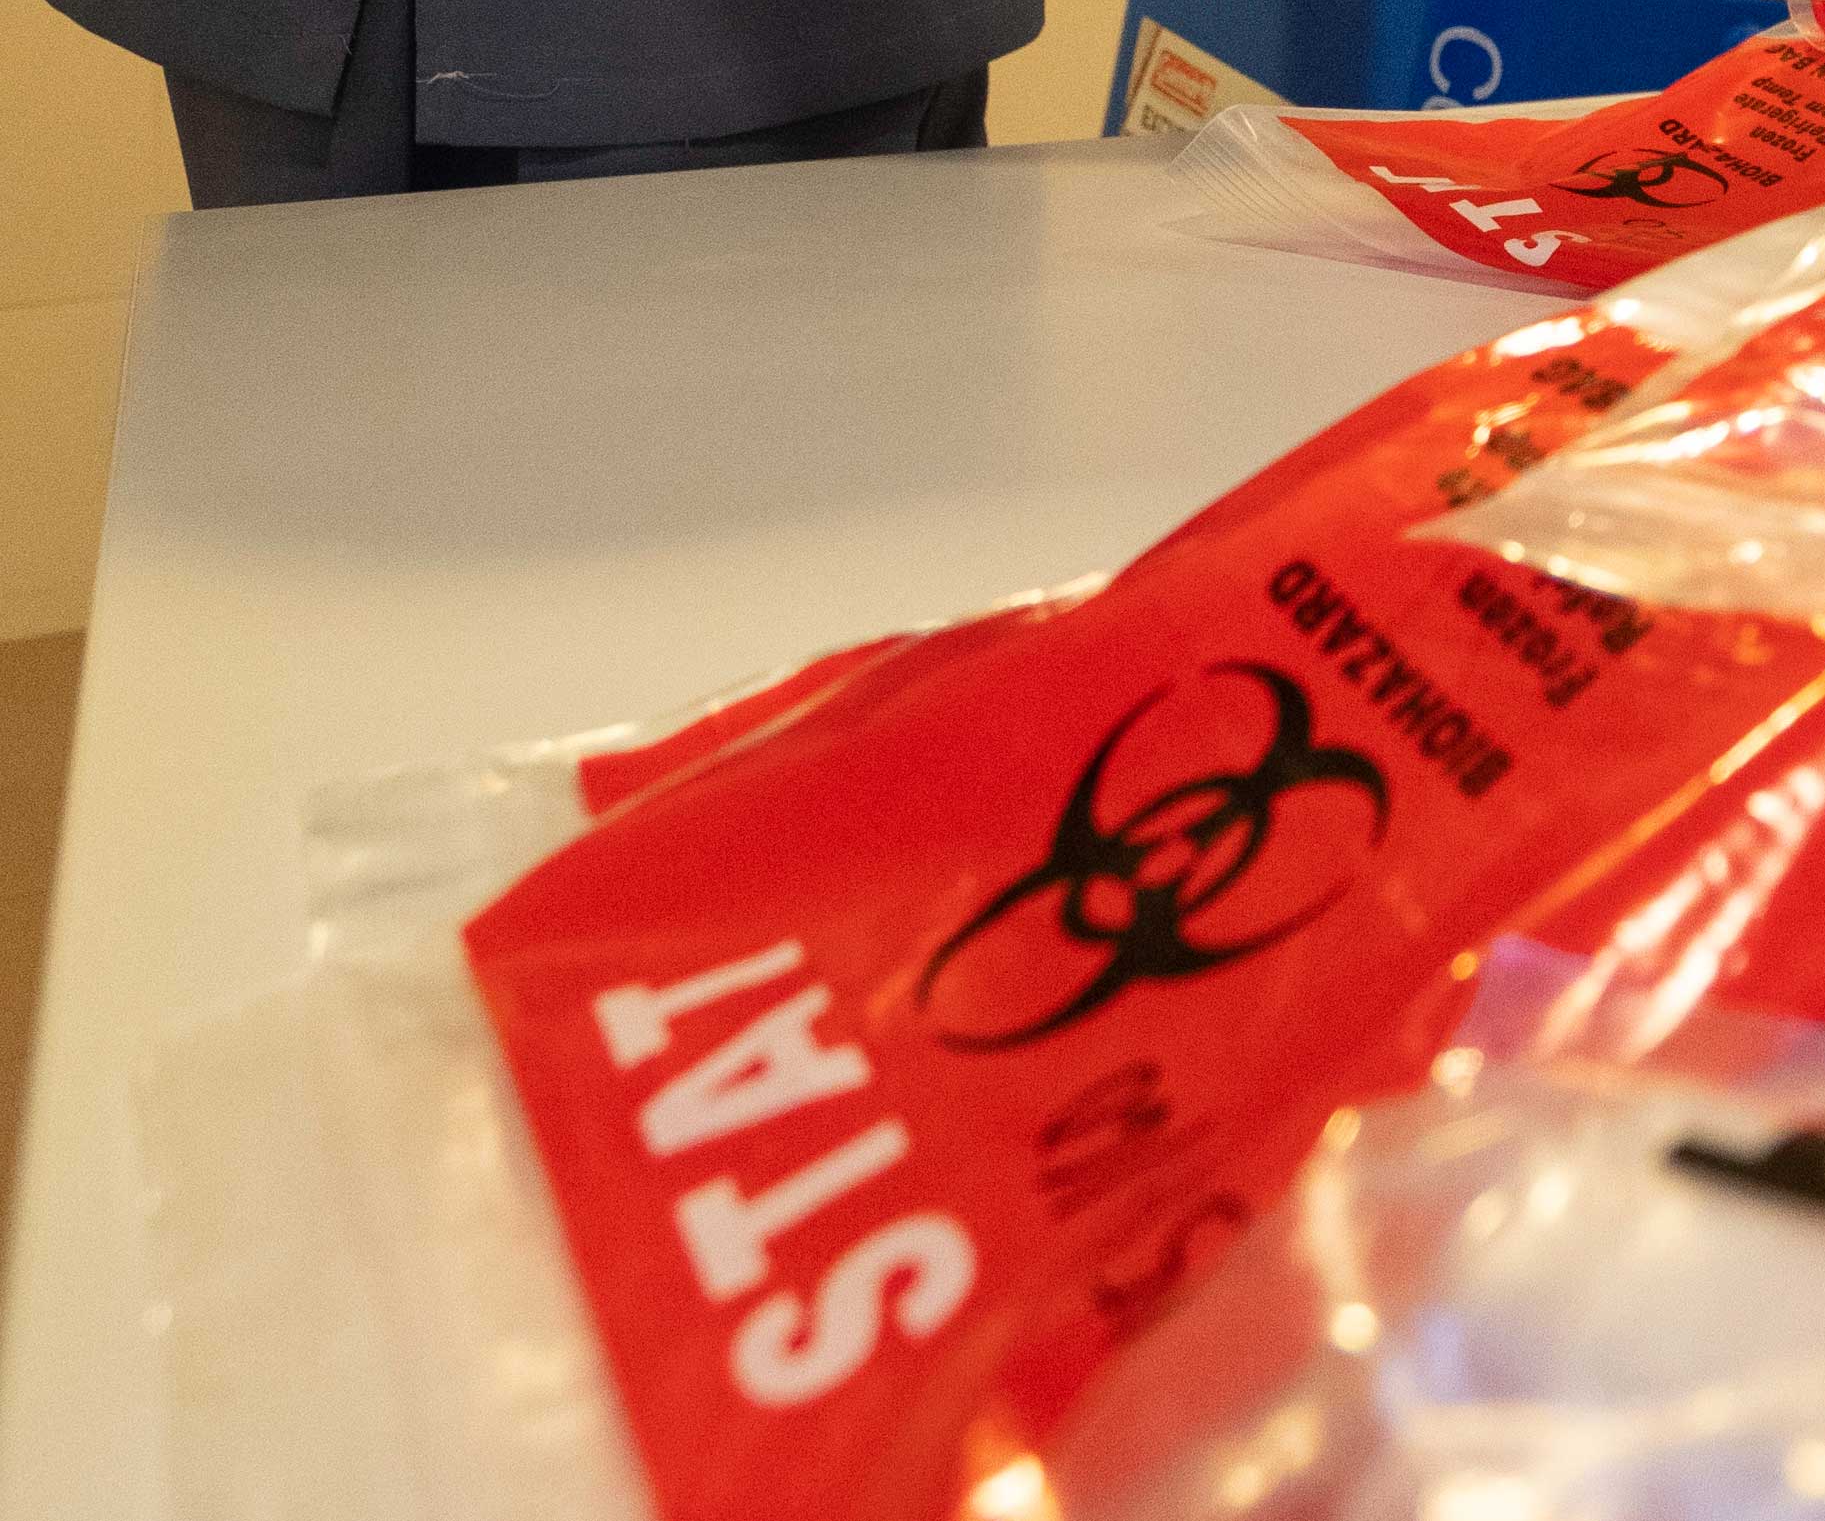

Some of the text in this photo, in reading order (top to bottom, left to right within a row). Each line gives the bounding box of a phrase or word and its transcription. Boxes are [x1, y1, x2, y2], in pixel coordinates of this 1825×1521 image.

[1748, 125, 1818, 165] Frozen
[1751, 77, 1803, 109] Temp
[1269, 559, 1513, 799] BIOHAZARD
[594, 939, 979, 1406] STAT
